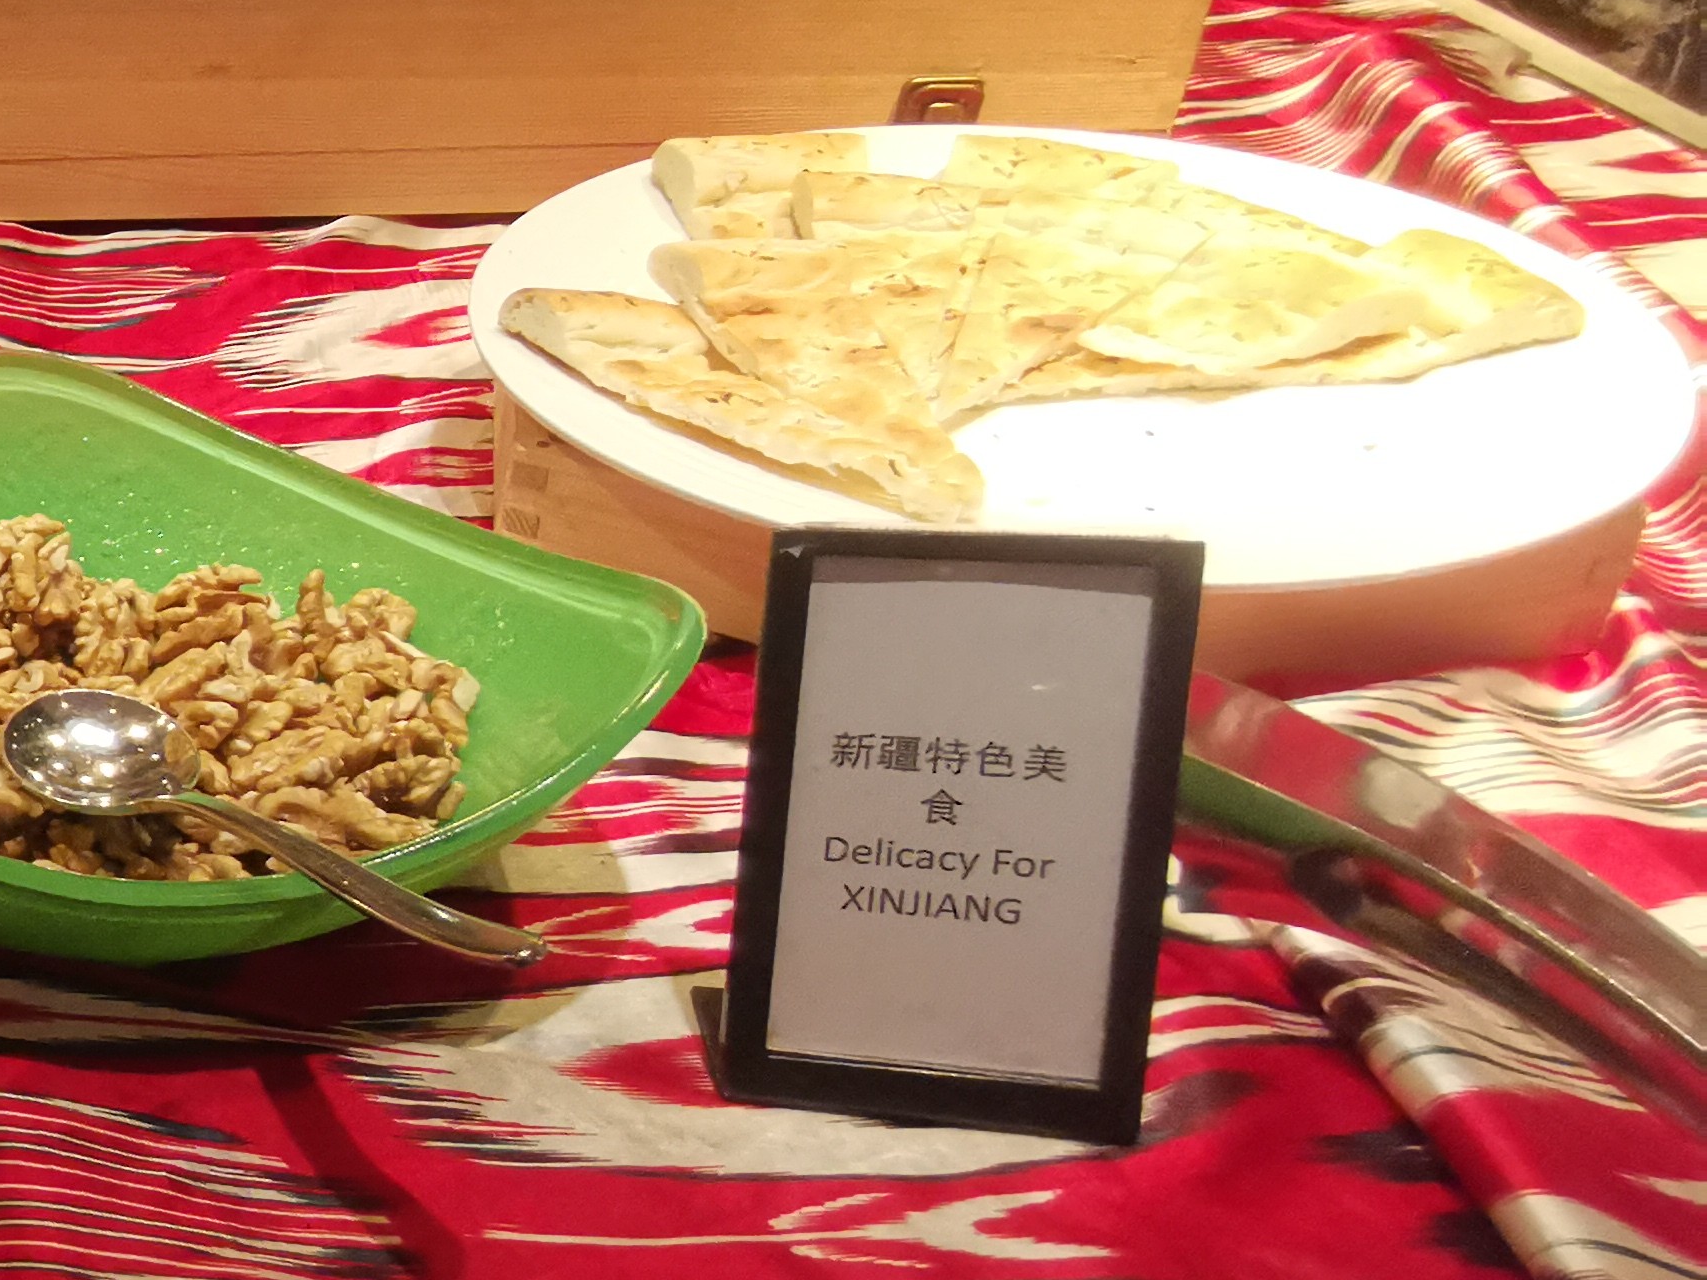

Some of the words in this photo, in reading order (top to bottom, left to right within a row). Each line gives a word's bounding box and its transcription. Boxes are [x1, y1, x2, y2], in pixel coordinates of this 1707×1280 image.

[830, 731, 1067, 783] 新疆特色美
[920, 788, 964, 826] 食
[823, 836, 981, 880] Delicacy
[992, 849, 1056, 879] For
[840, 883, 1023, 925] XINJIANG
